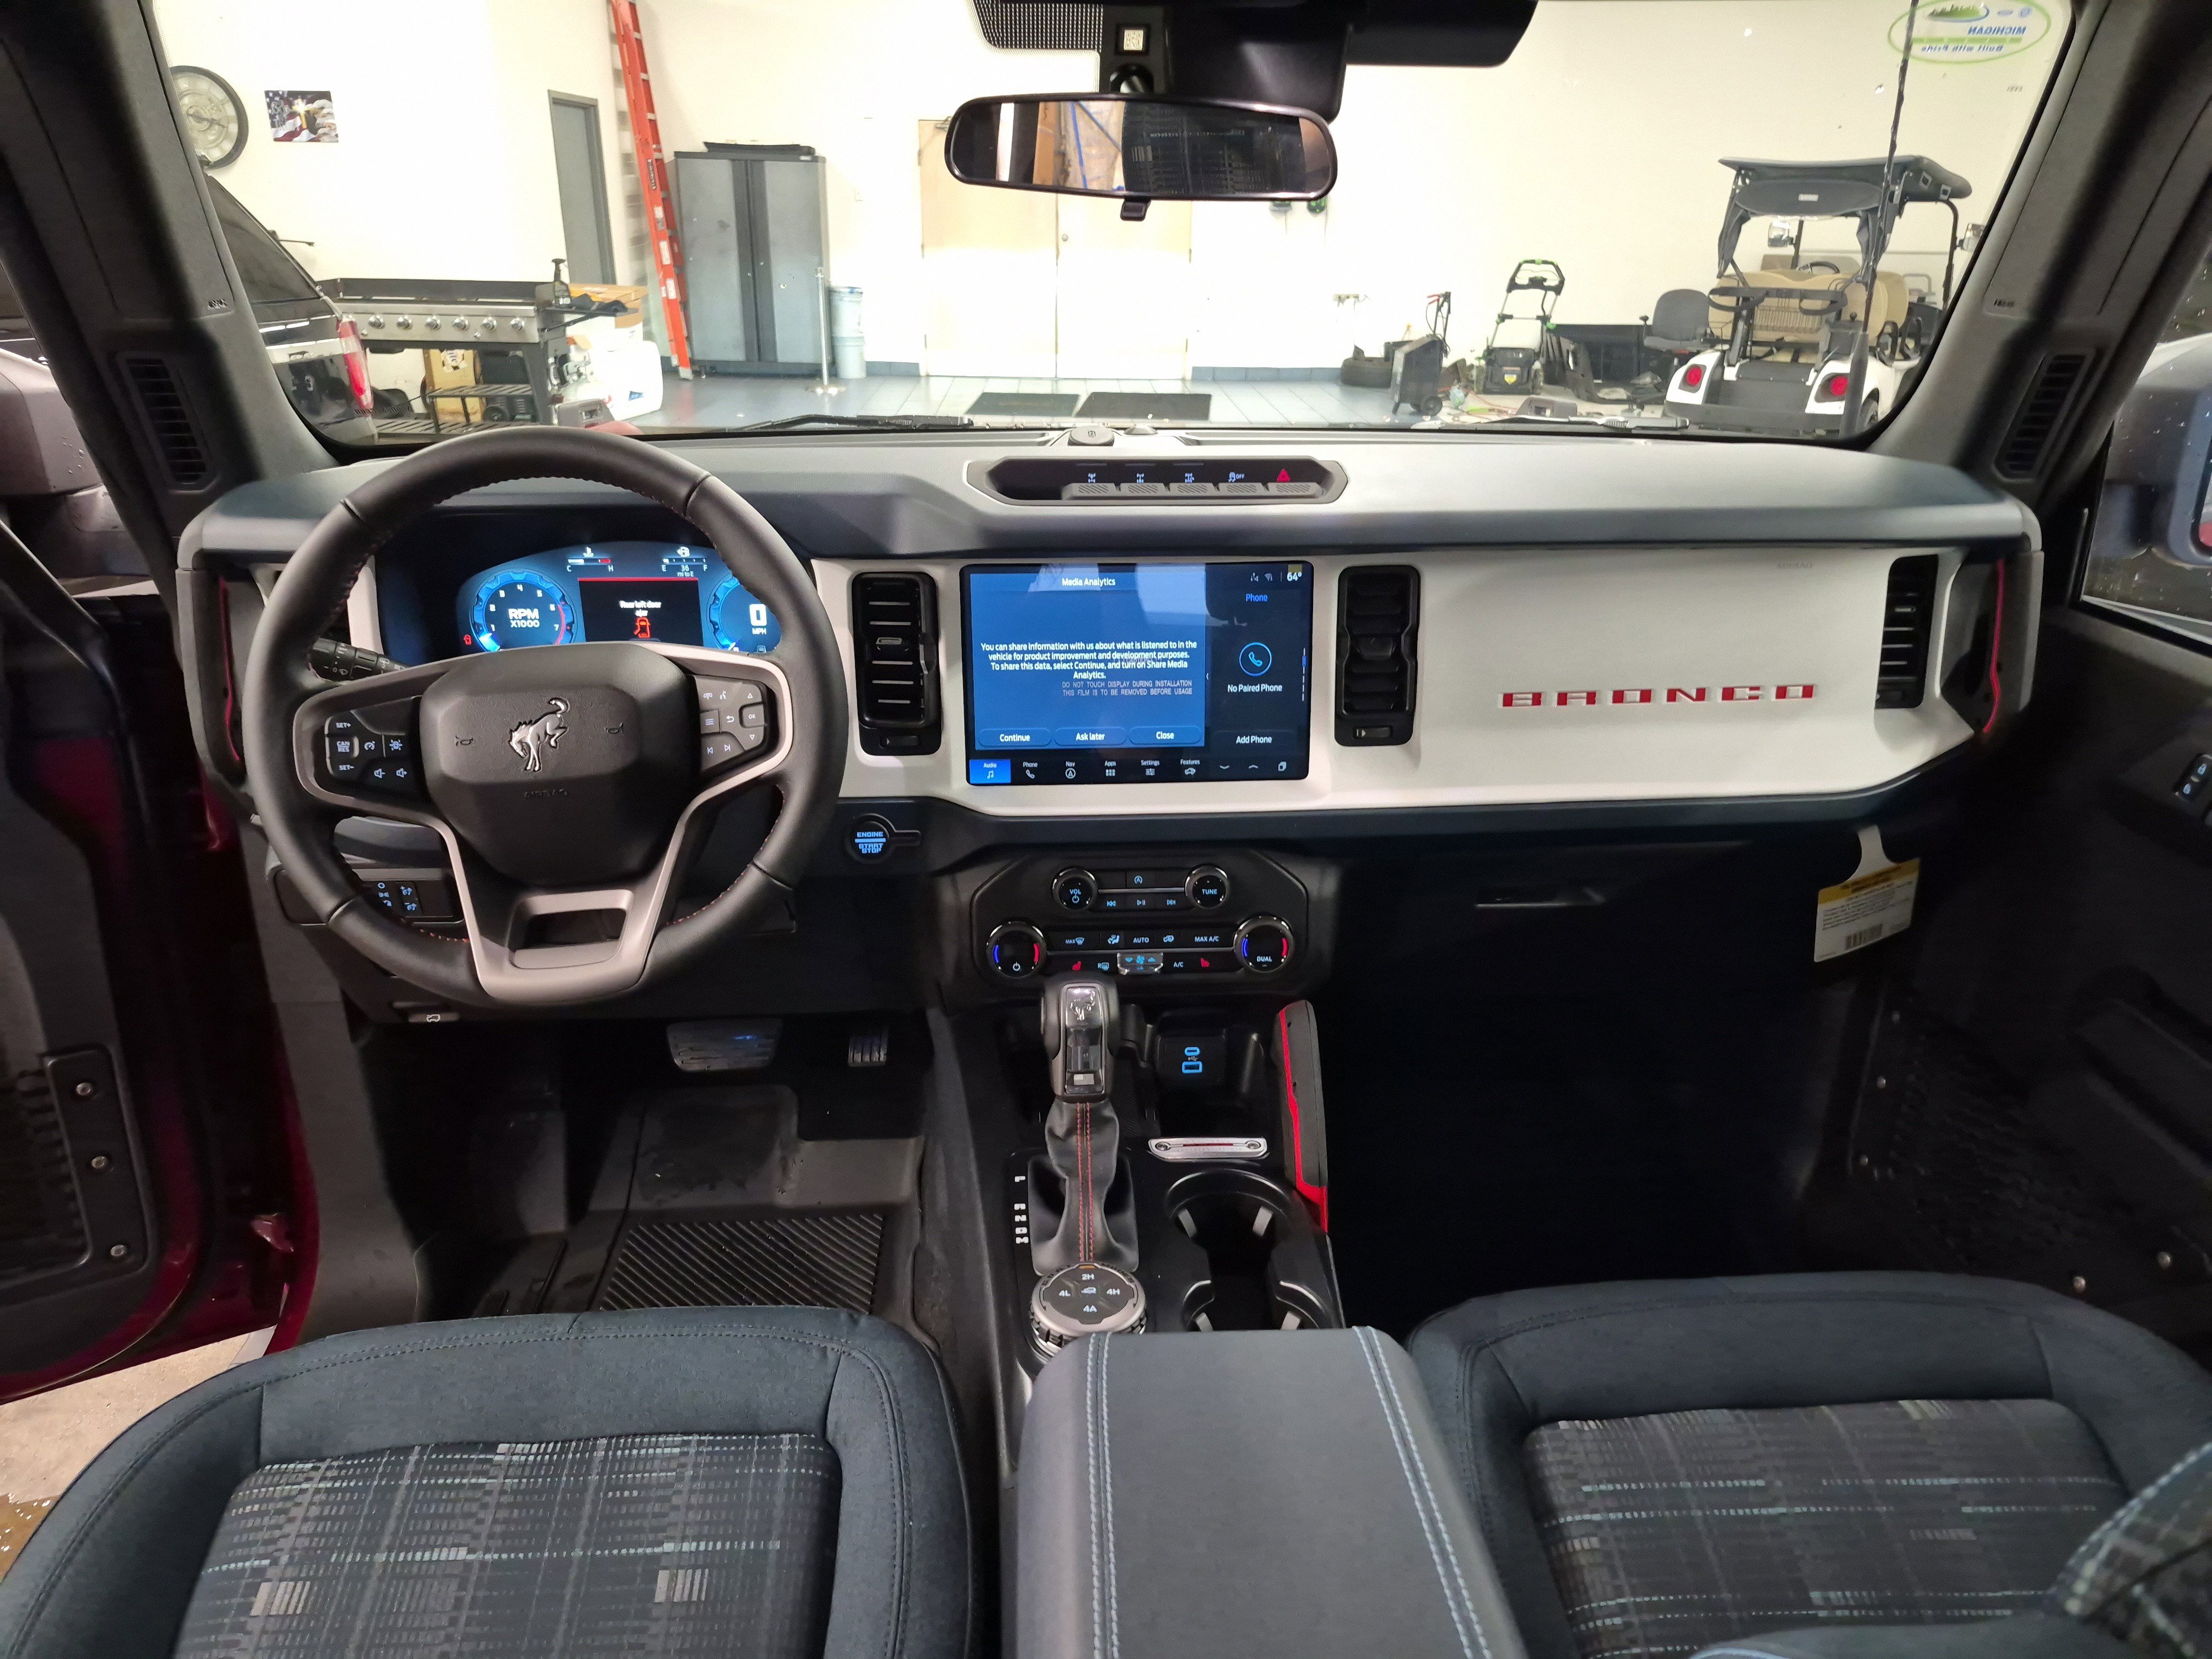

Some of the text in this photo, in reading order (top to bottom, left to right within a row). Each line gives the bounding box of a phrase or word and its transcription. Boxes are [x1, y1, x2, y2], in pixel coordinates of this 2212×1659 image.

[1062, 577, 1116, 587] Media Analytics
[1246, 593, 1268, 602] Phone
[509, 608, 539, 619] RPM
[749, 603, 767, 626] 0
[510, 620, 540, 628] X1000
[1009, 642, 1027, 651] share
[1095, 641, 1115, 650] about
[1142, 641, 1168, 649] listened
[1185, 640, 1197, 648] the
[988, 651, 1190, 661] vehicle for product improvement and development purposes.
[991, 662, 999, 670] To
[1001, 662, 1020, 670] share
[1020, 662, 1033, 670] this
[1034, 661, 1052, 671] data,
[1053, 661, 1073, 670] select
[1075, 661, 1107, 670] Continue,
[1107, 661, 1121, 669] and
[1147, 660, 1166, 668] Share
[1167, 660, 1188, 668] Media
[1073, 671, 1106, 680] Analytics.
[1227, 684, 1283, 692] No Paired Phone
[1501, 685, 1815, 707] BRONCO
[1000, 734, 1030, 742] Continue
[1076, 732, 1105, 741] Ask later
[1156, 731, 1174, 740] Close
[1236, 735, 1272, 744] Add Phone
